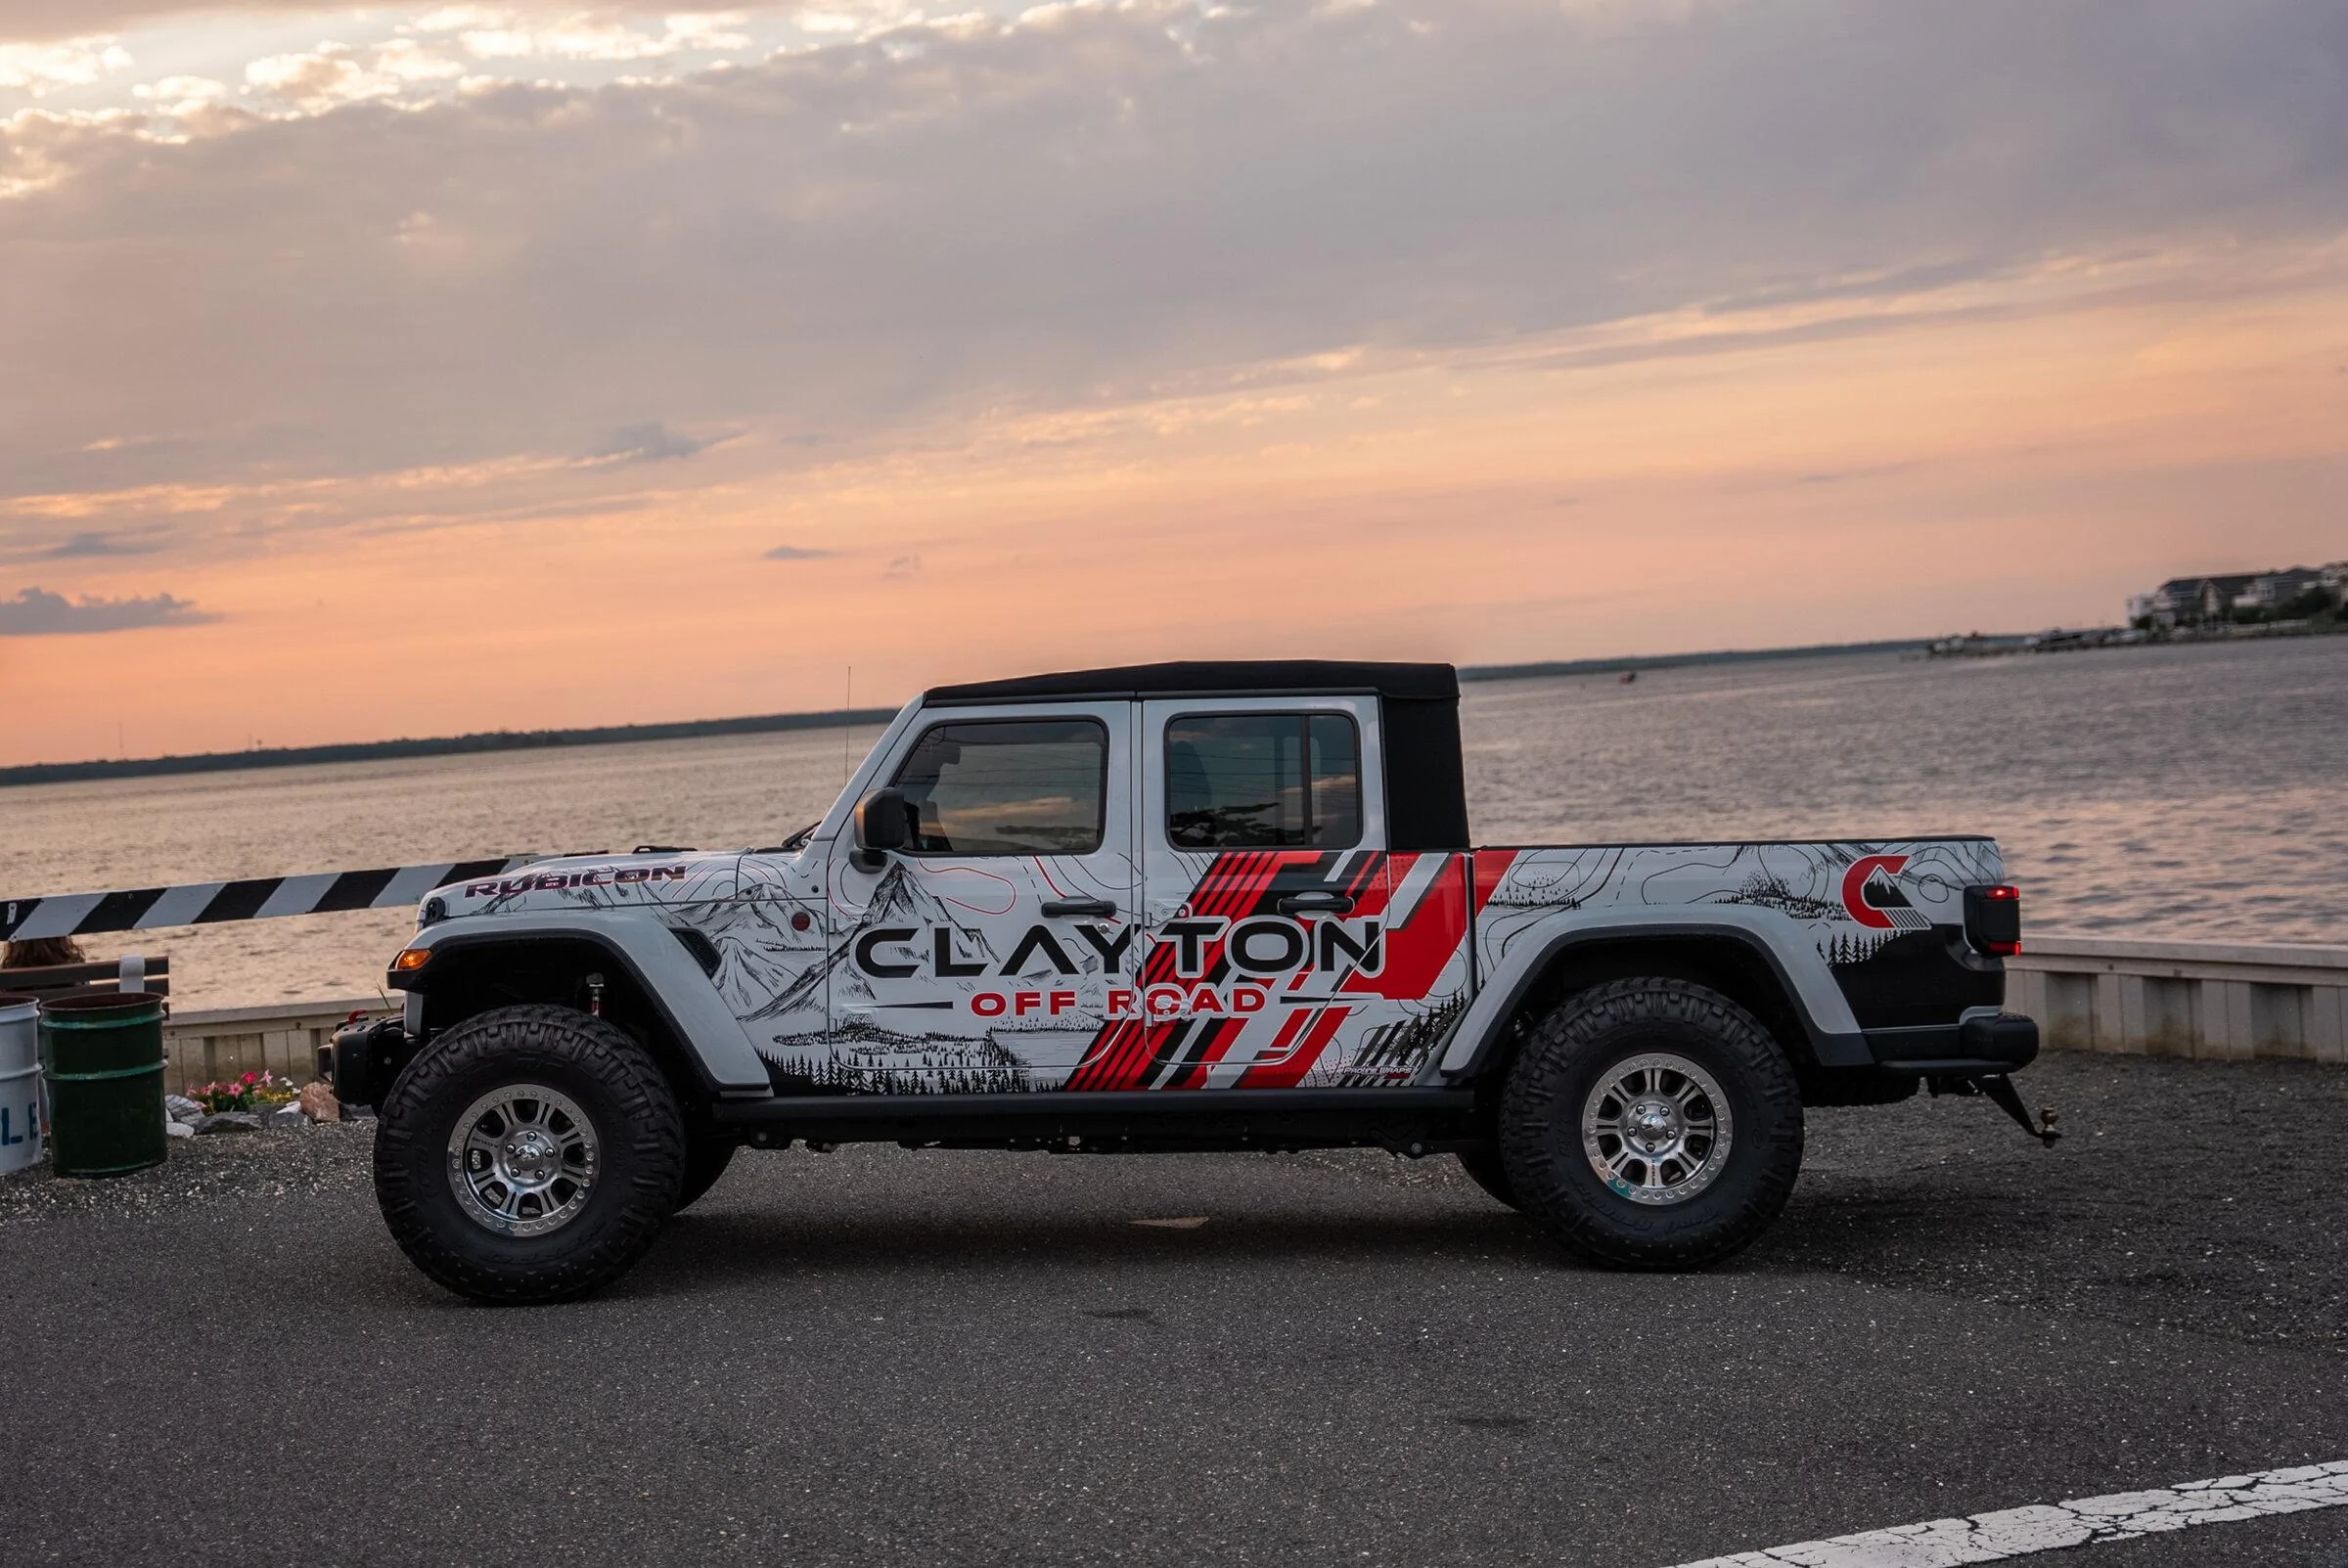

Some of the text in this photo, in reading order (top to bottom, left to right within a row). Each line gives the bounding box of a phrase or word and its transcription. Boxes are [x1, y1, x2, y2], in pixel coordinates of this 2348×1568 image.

[464, 865, 687, 899] RUBICON
[854, 919, 1380, 979] CLAYTON
[970, 987, 1266, 1017] OFF ROAD
